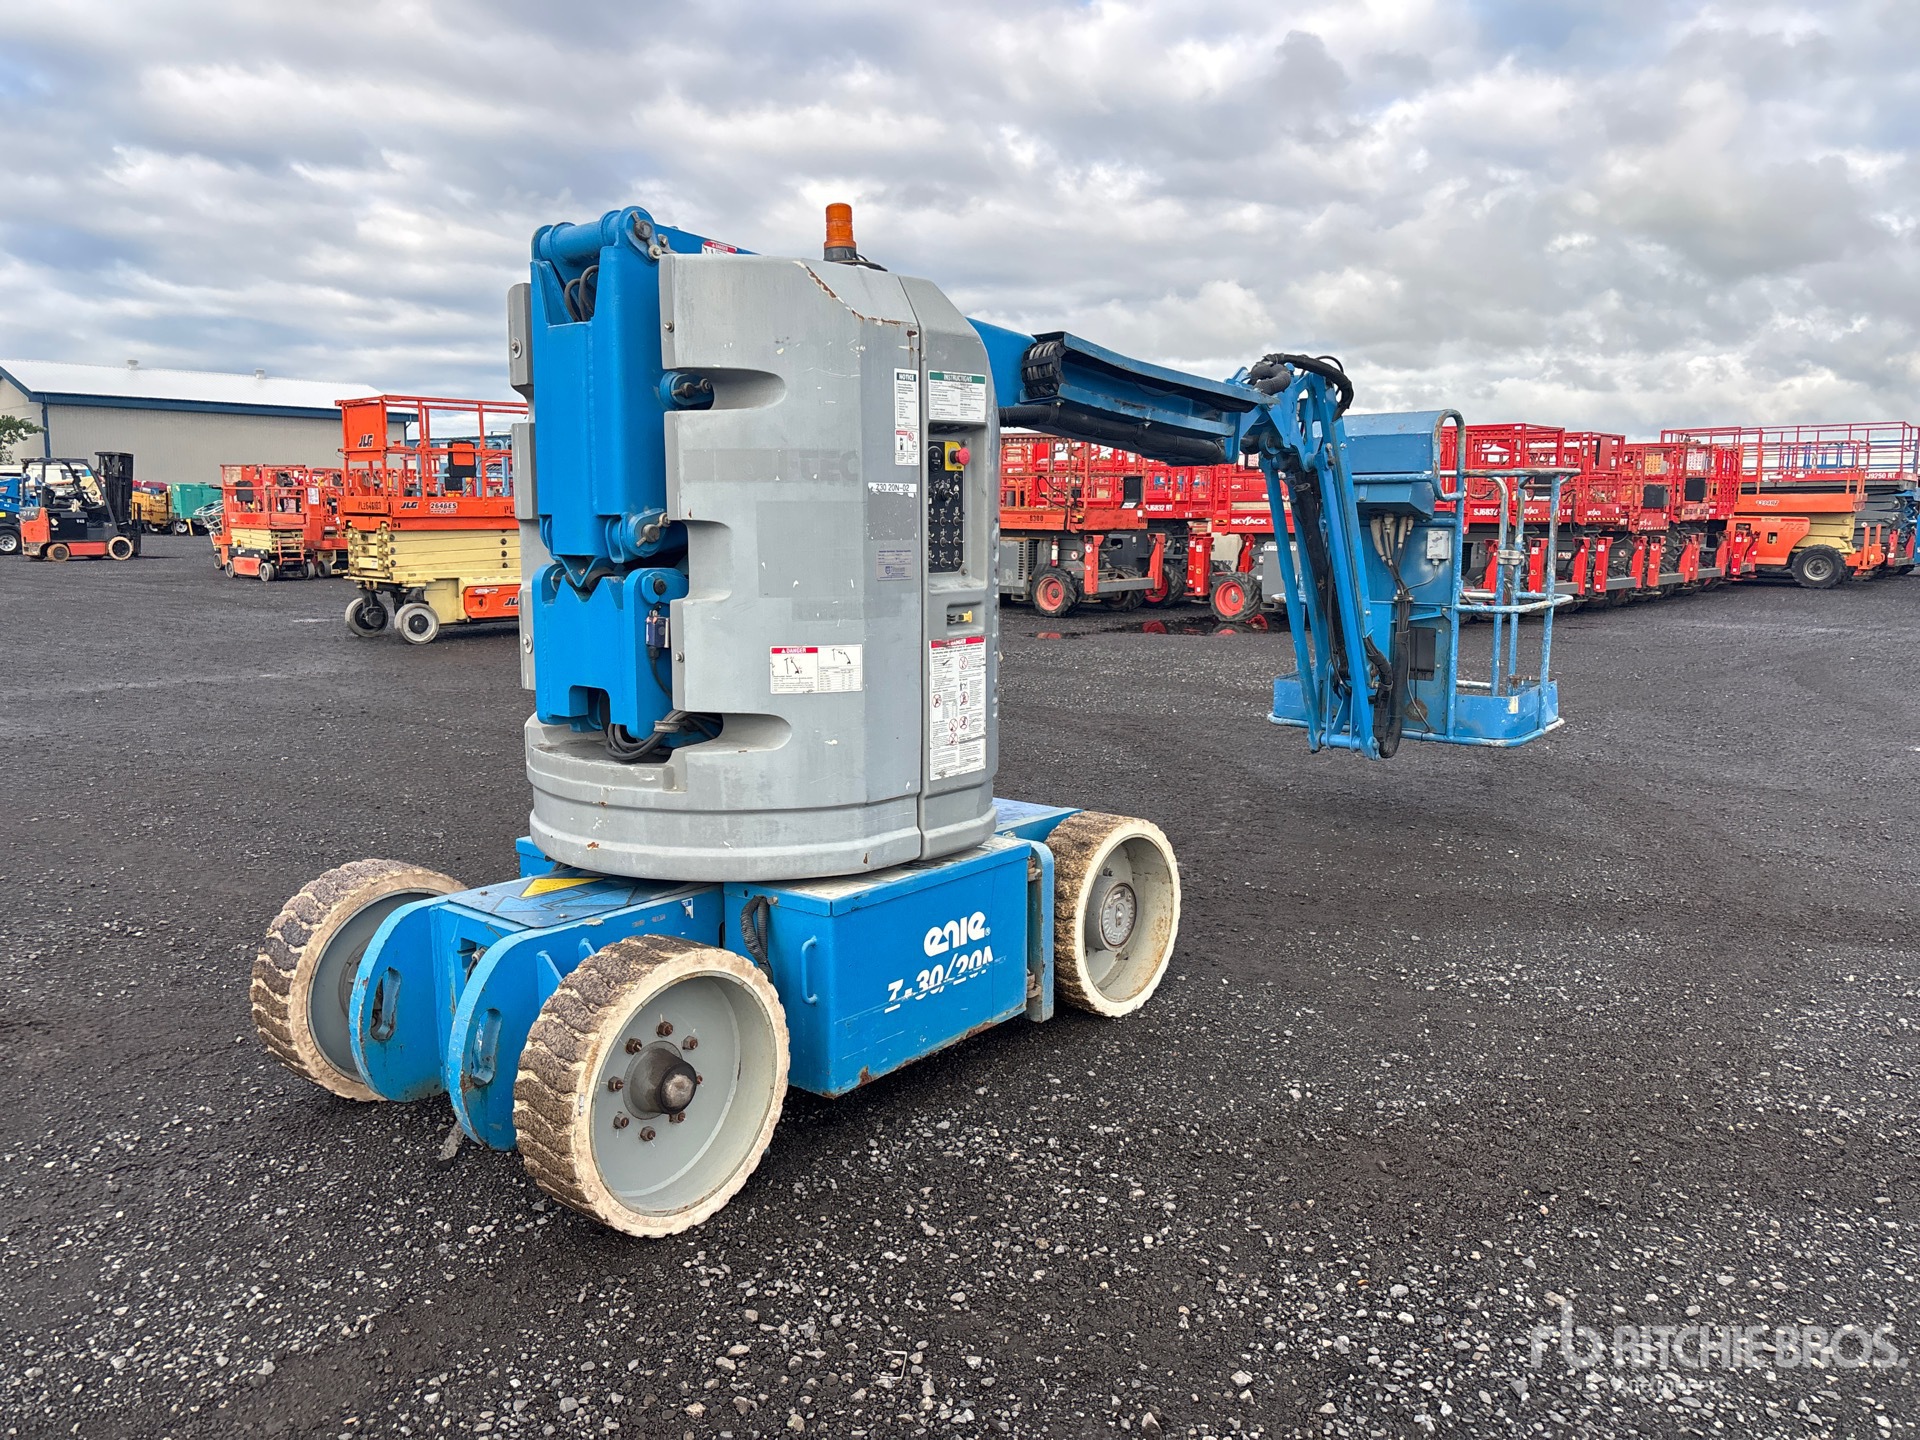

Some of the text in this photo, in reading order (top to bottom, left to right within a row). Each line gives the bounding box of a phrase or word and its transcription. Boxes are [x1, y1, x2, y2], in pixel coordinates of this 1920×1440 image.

[898, 373, 914, 381] NOTICE
[943, 373, 972, 383] INSTRUCTIONS
[358, 434, 374, 448] JLG
[1231, 516, 1267, 526] SKYJACK
